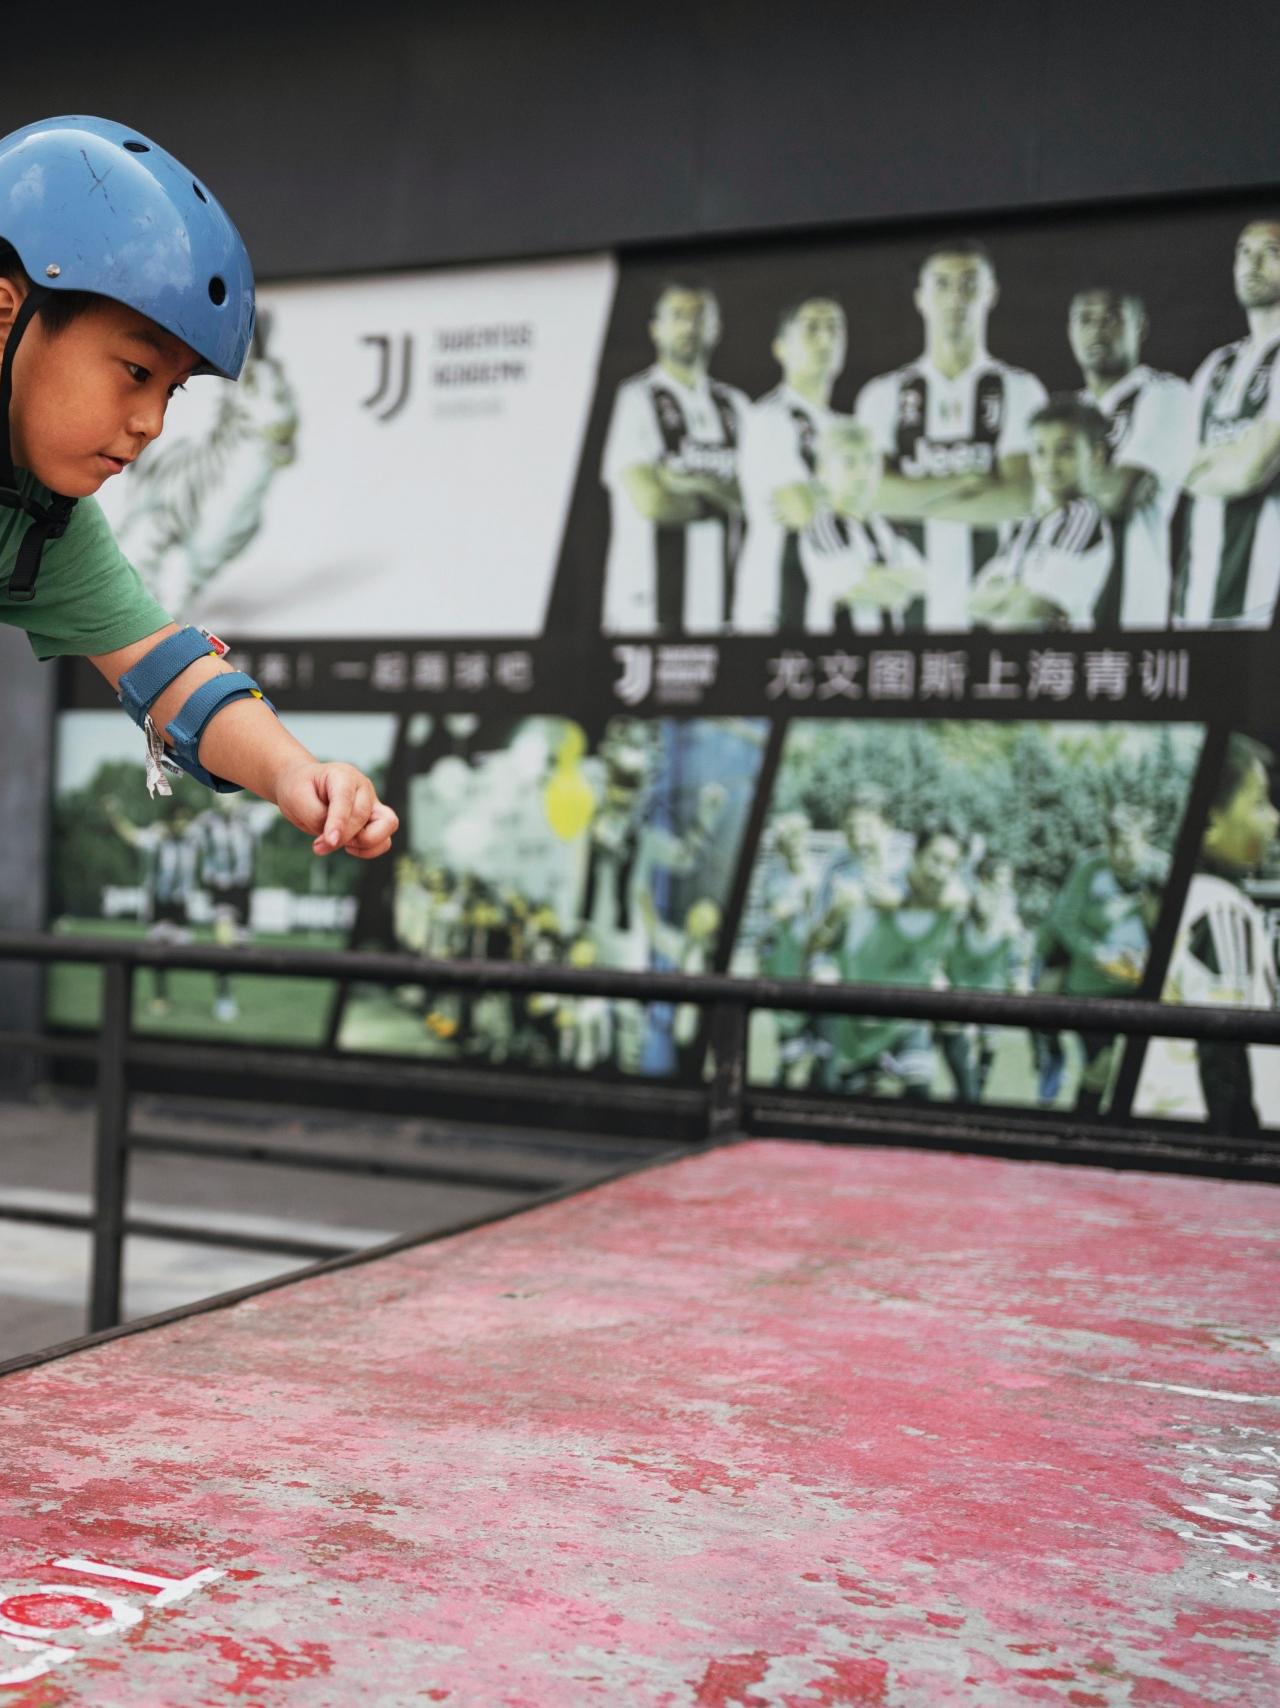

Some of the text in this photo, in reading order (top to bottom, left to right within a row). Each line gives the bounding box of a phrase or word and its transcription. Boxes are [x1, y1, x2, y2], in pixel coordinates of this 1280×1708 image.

[767, 649, 1189, 700] 尤文图斯上海青训
